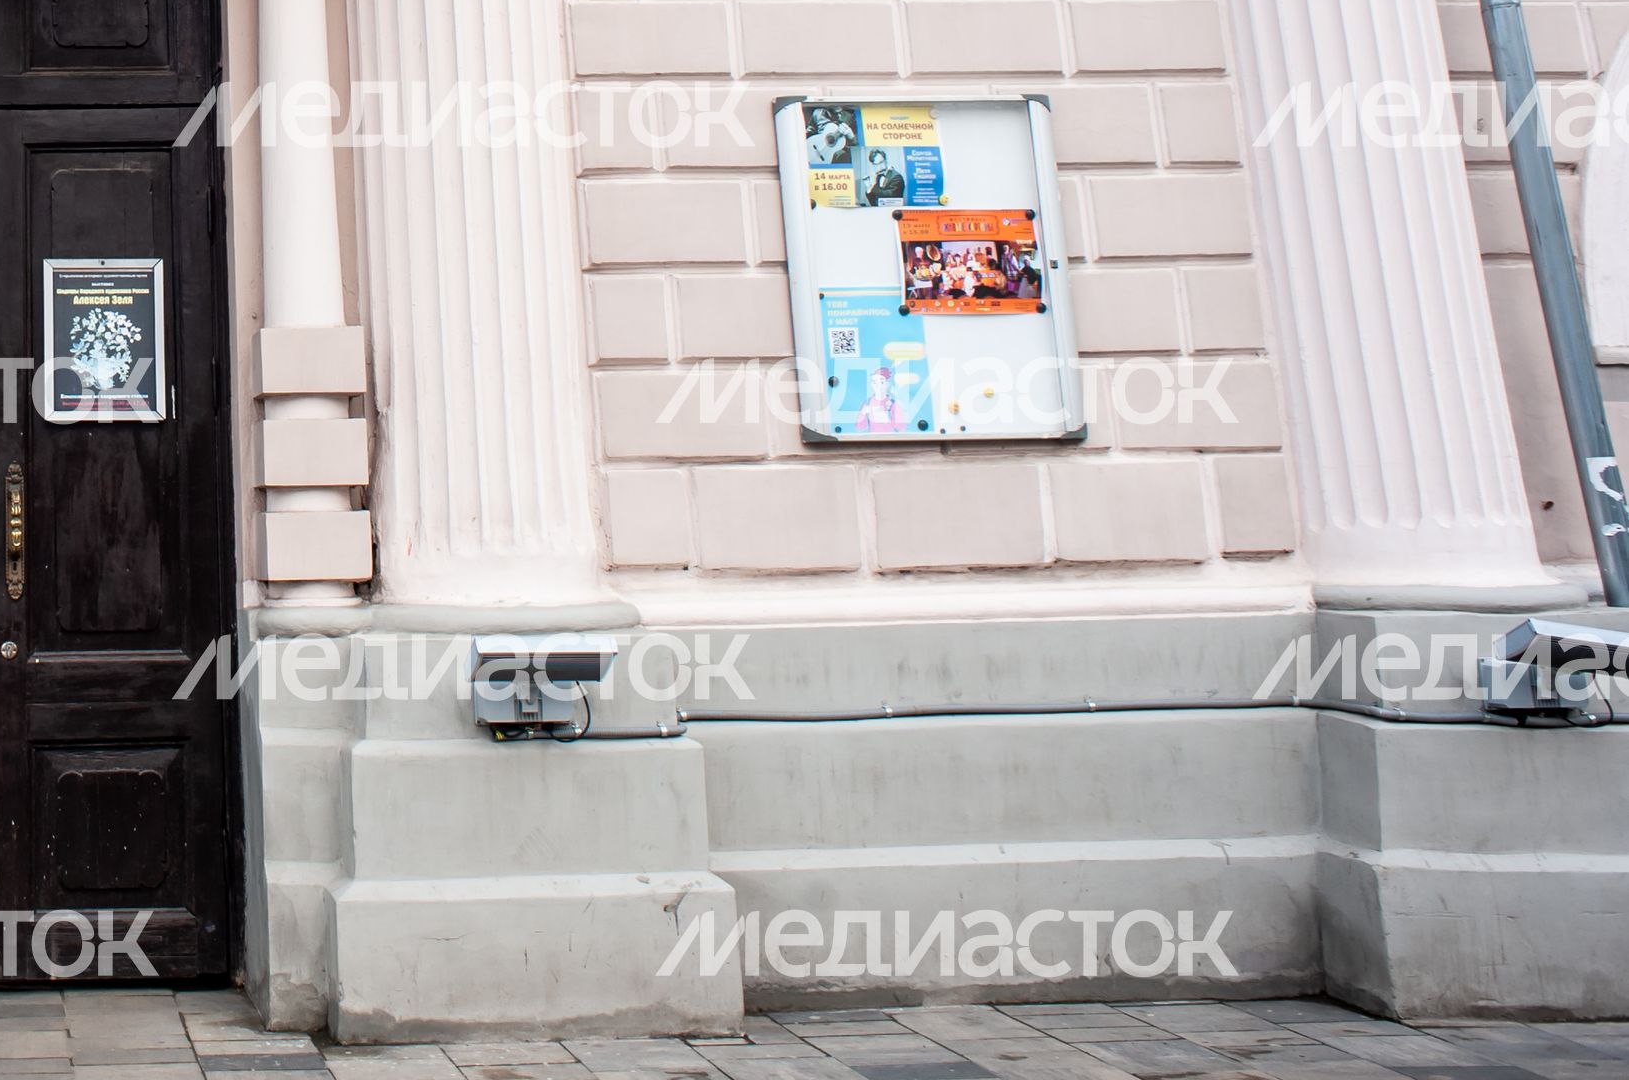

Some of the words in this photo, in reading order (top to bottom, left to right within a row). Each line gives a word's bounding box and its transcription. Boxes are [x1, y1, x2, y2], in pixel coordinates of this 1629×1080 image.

[881, 121, 934, 130] СОЛНЕЧНОЙ
[882, 132, 923, 140] СТОРОНЕ
[822, 183, 848, 191] 16.00
[73, 295, 110, 305] Алексея
[111, 295, 133, 305] Зеля
